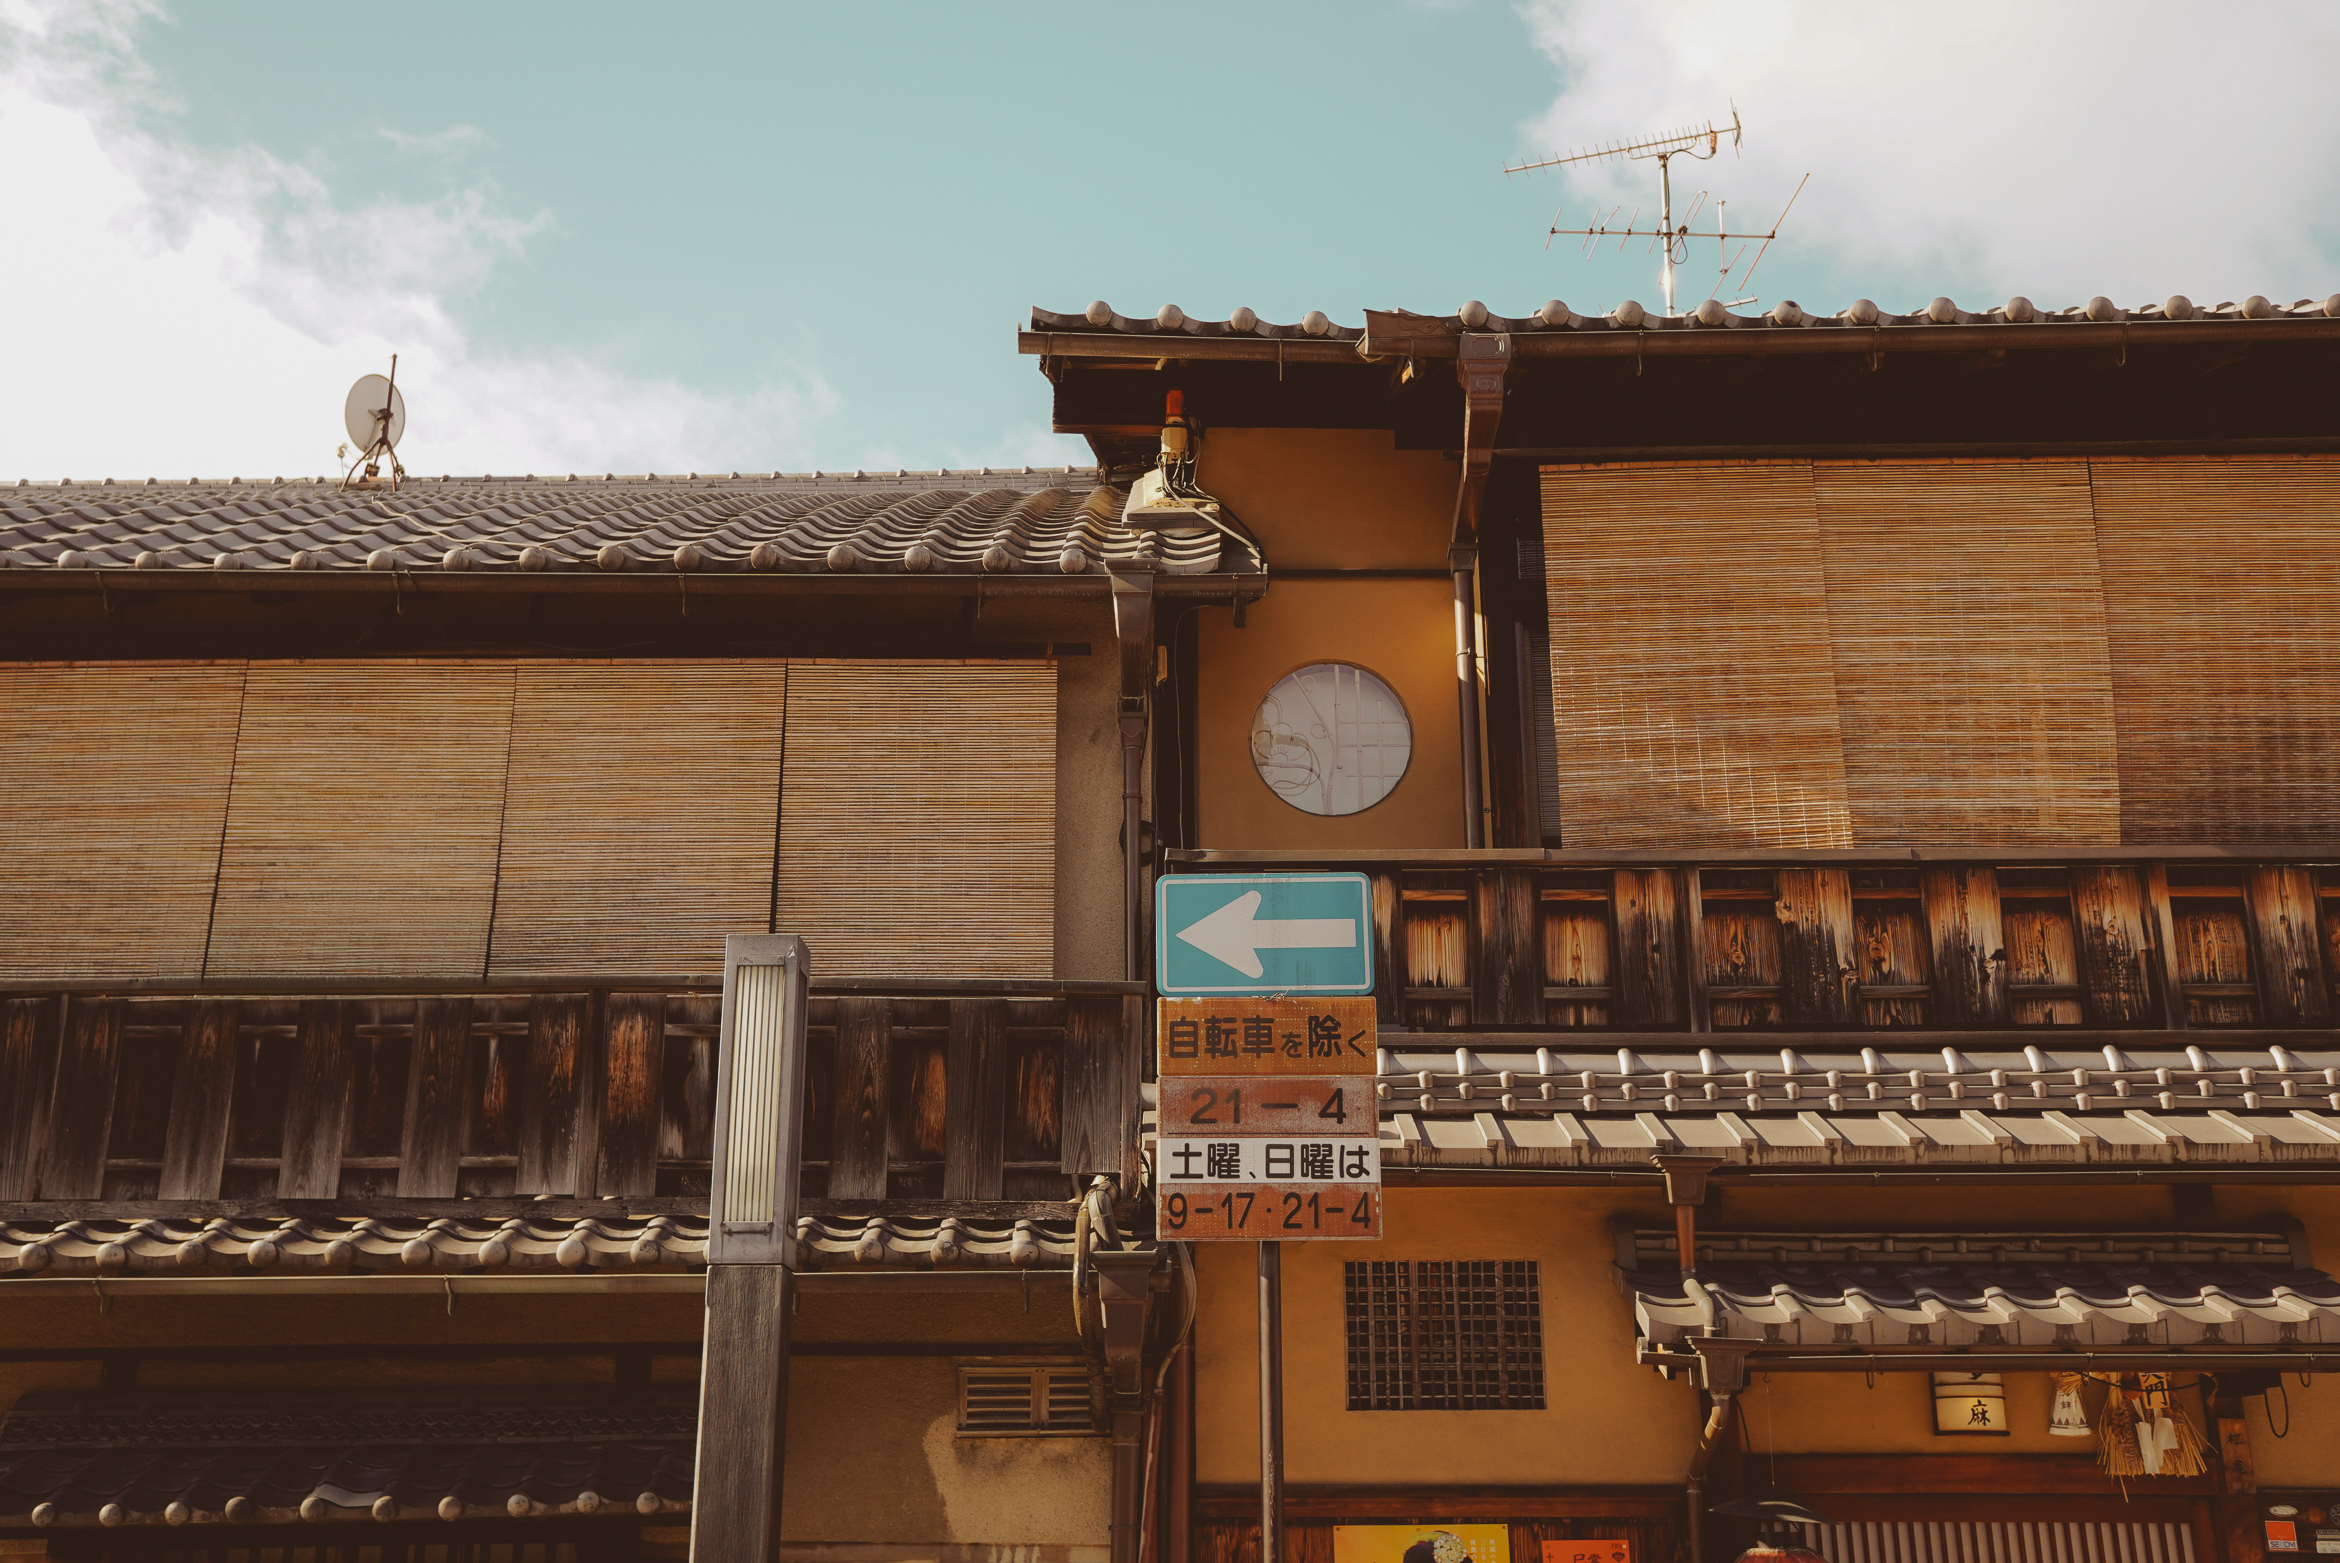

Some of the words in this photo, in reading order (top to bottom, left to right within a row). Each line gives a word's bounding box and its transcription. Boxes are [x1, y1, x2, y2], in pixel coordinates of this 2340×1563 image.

[1168, 1015, 1367, 1059] 自転車を除く
[1169, 1143, 1371, 1180] 土曜、日曜は
[2270, 1540, 2296, 1548] SECOM
